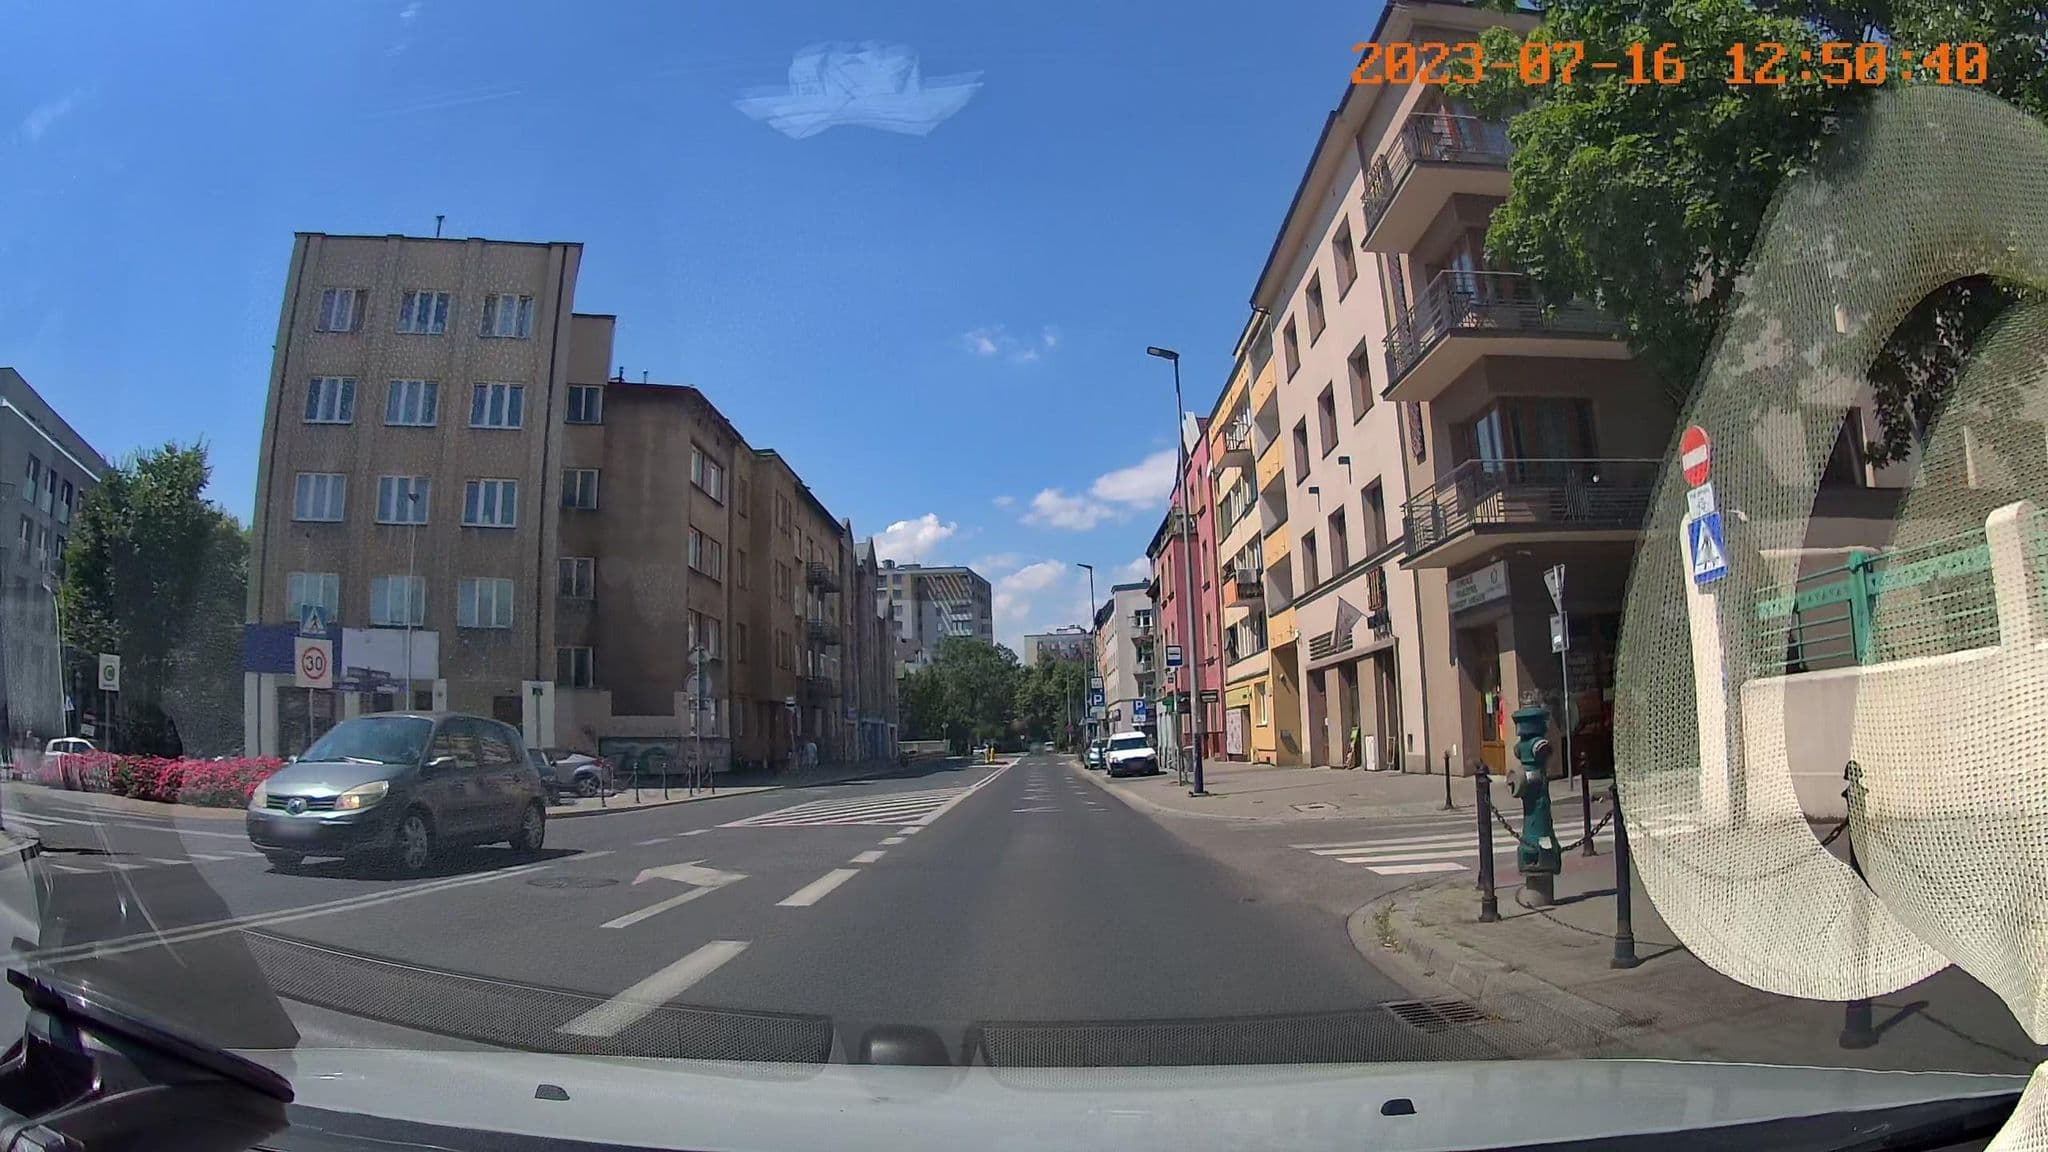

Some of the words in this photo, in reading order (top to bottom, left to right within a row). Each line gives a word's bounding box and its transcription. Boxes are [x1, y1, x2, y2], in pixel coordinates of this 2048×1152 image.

[305, 655, 323, 671] 30
[1093, 694, 1103, 706] P
[1135, 700, 1144, 711] P
